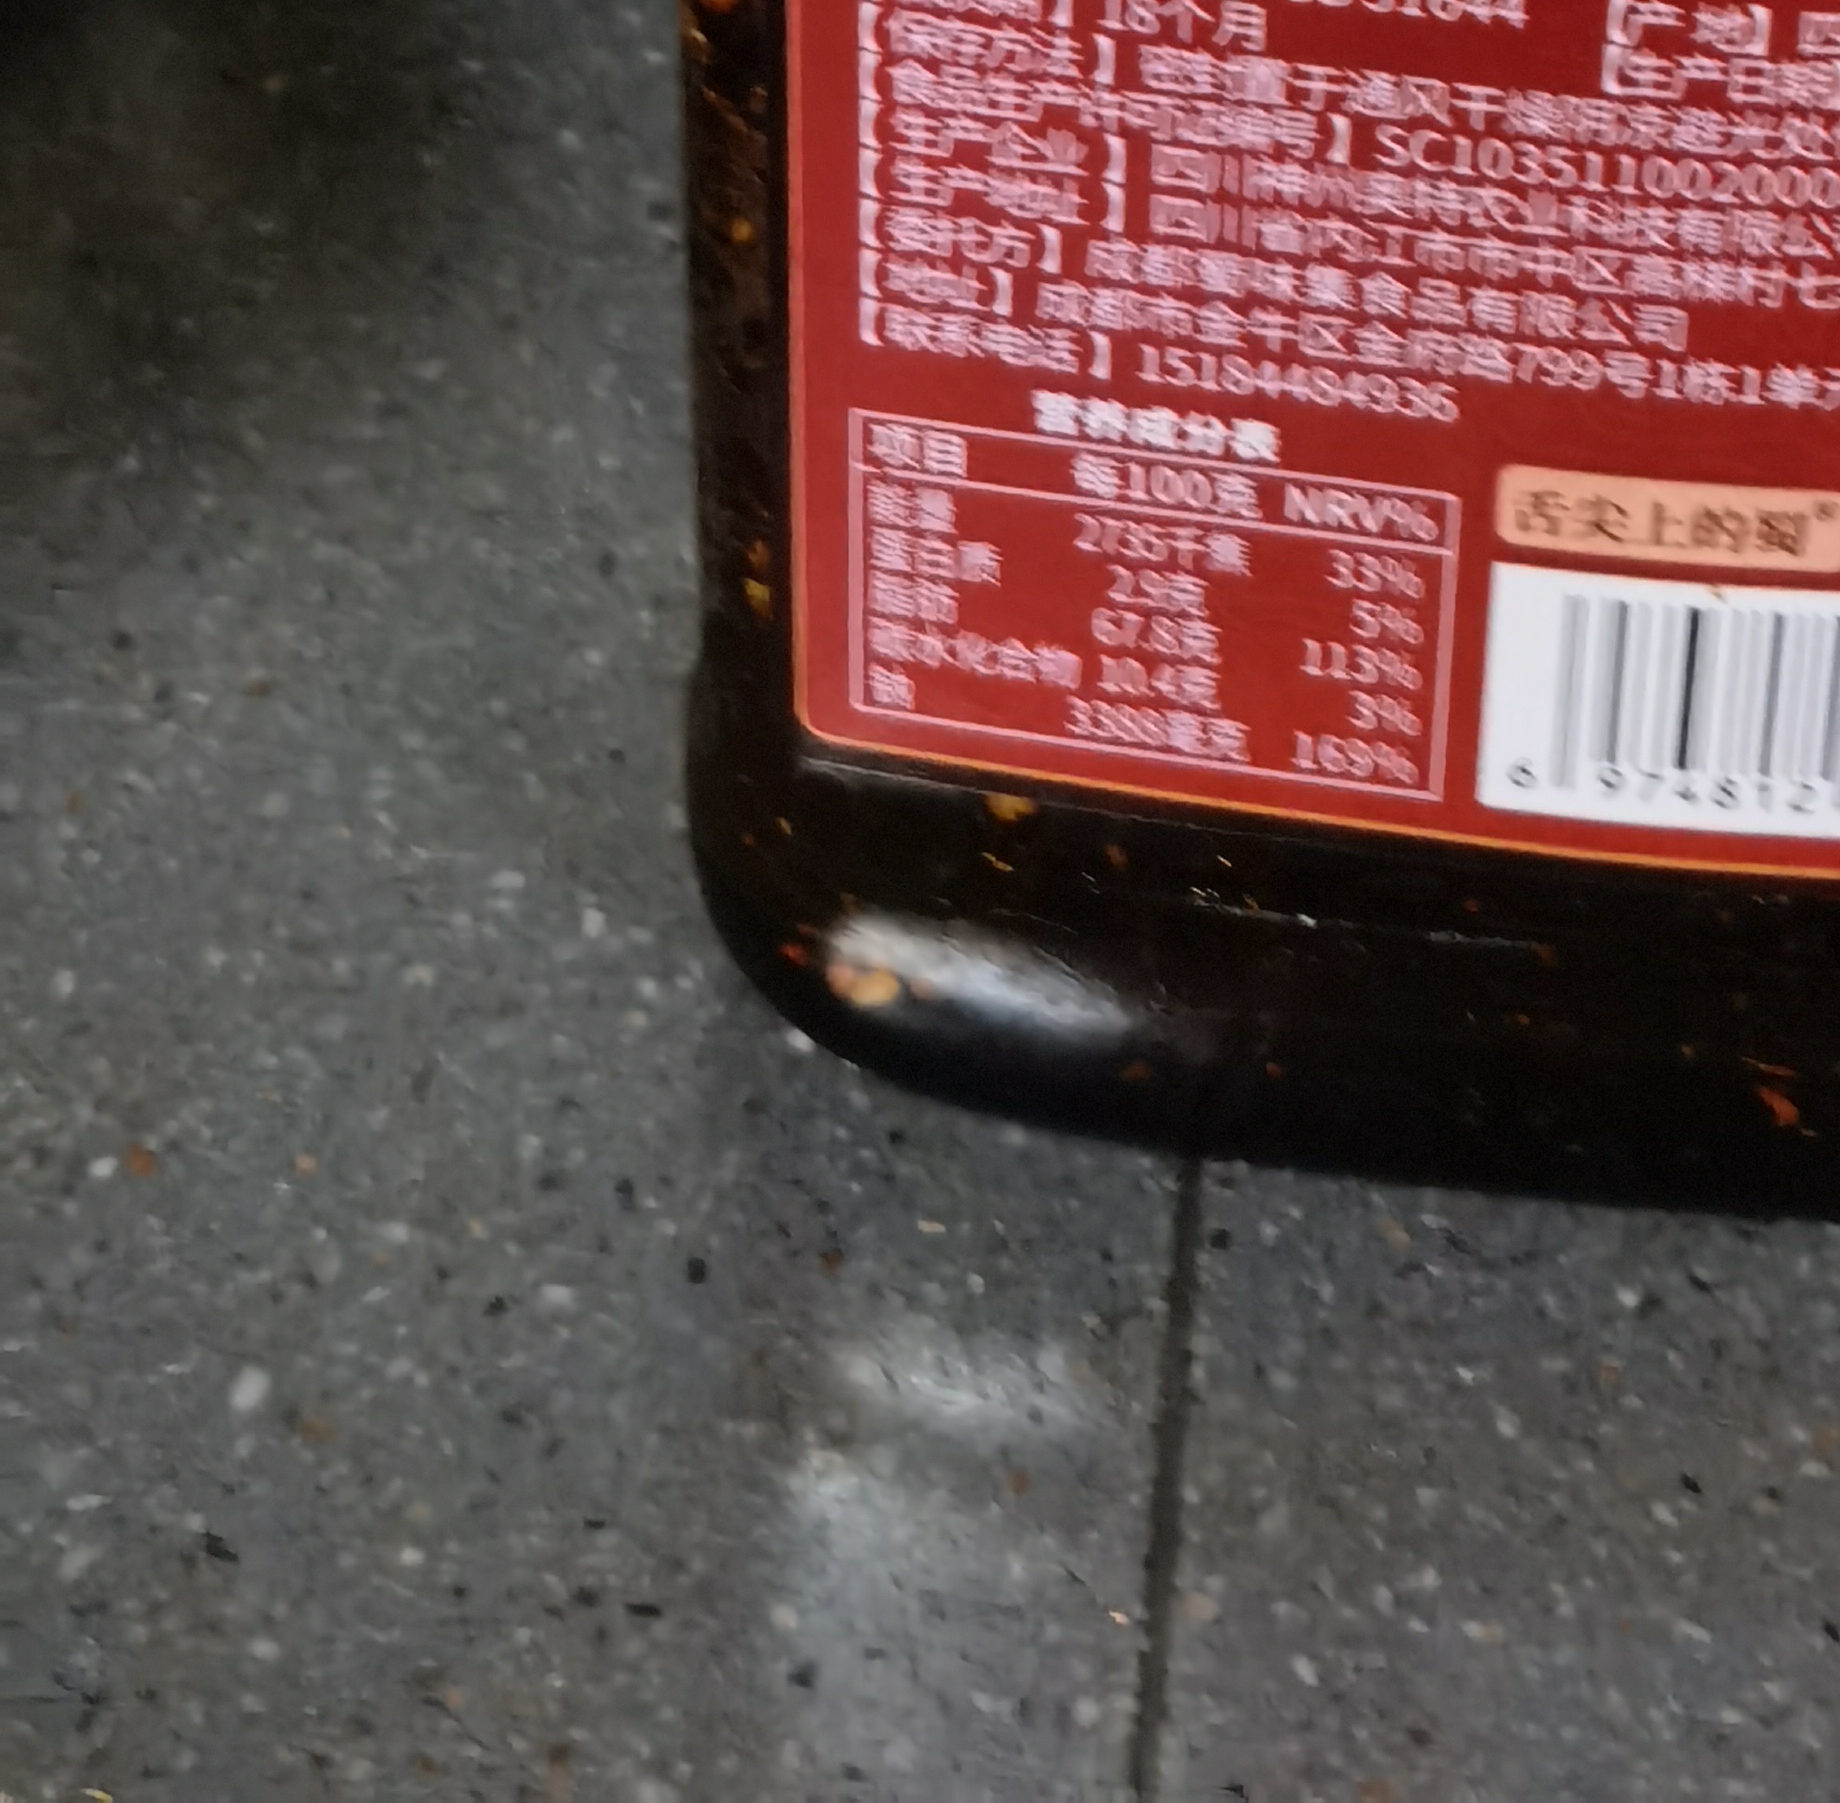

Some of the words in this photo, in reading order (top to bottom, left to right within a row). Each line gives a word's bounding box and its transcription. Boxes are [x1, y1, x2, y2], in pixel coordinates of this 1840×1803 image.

[868, 422, 968, 478] 项目
[1071, 451, 1263, 520] 每100克
[1283, 483, 1440, 542] NRV%
[1032, 389, 1281, 463] 营养成分表
[867, 481, 957, 534] 能量
[1325, 549, 1425, 599] 33%
[867, 526, 1003, 586] 蛋白质
[1349, 599, 1424, 646] 5%
[867, 616, 1083, 691] 碳水化合物
[1345, 691, 1423, 736] 3%
[868, 570, 959, 625] 脂肪
[1301, 638, 1423, 692] 113%
[868, 665, 916, 710] 钠
[1291, 730, 1420, 786] 169%
